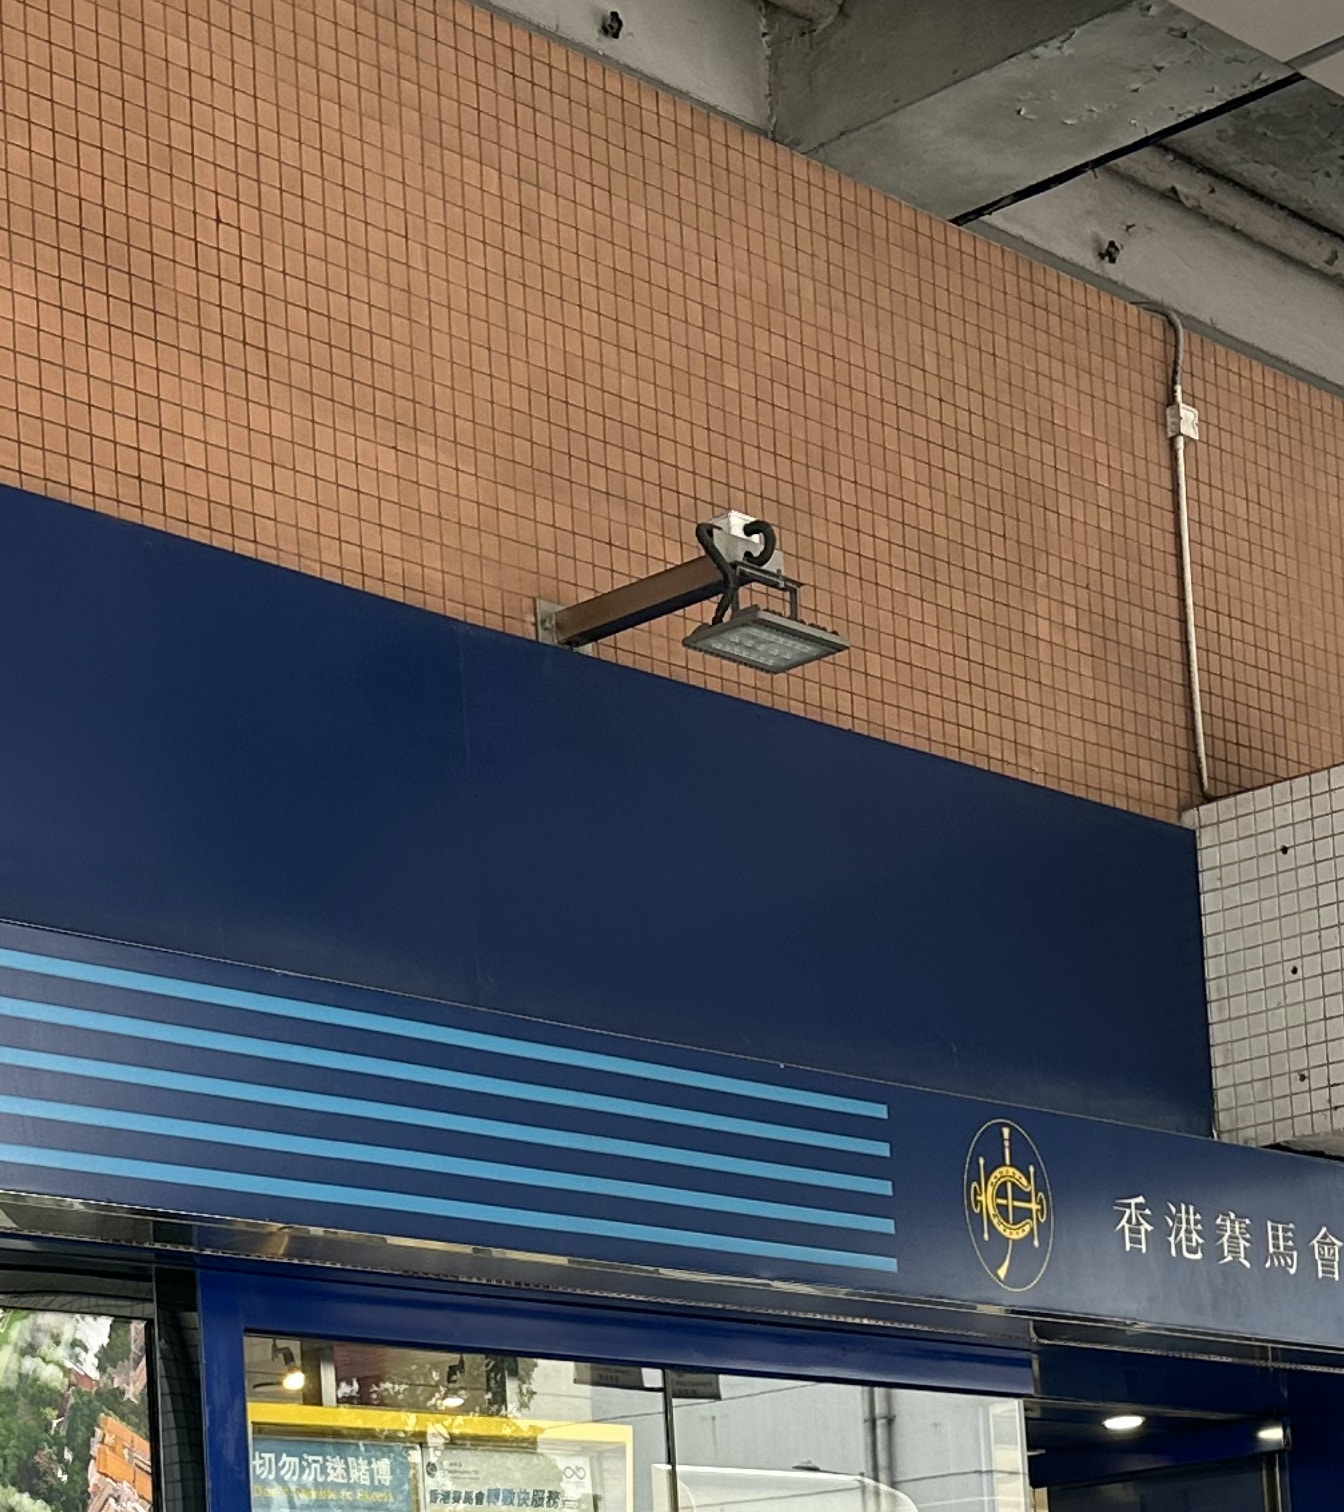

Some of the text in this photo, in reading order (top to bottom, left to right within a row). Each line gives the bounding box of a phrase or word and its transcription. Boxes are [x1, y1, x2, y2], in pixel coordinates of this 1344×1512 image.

[253, 1451, 393, 1486] 切勿沉迷賭博
